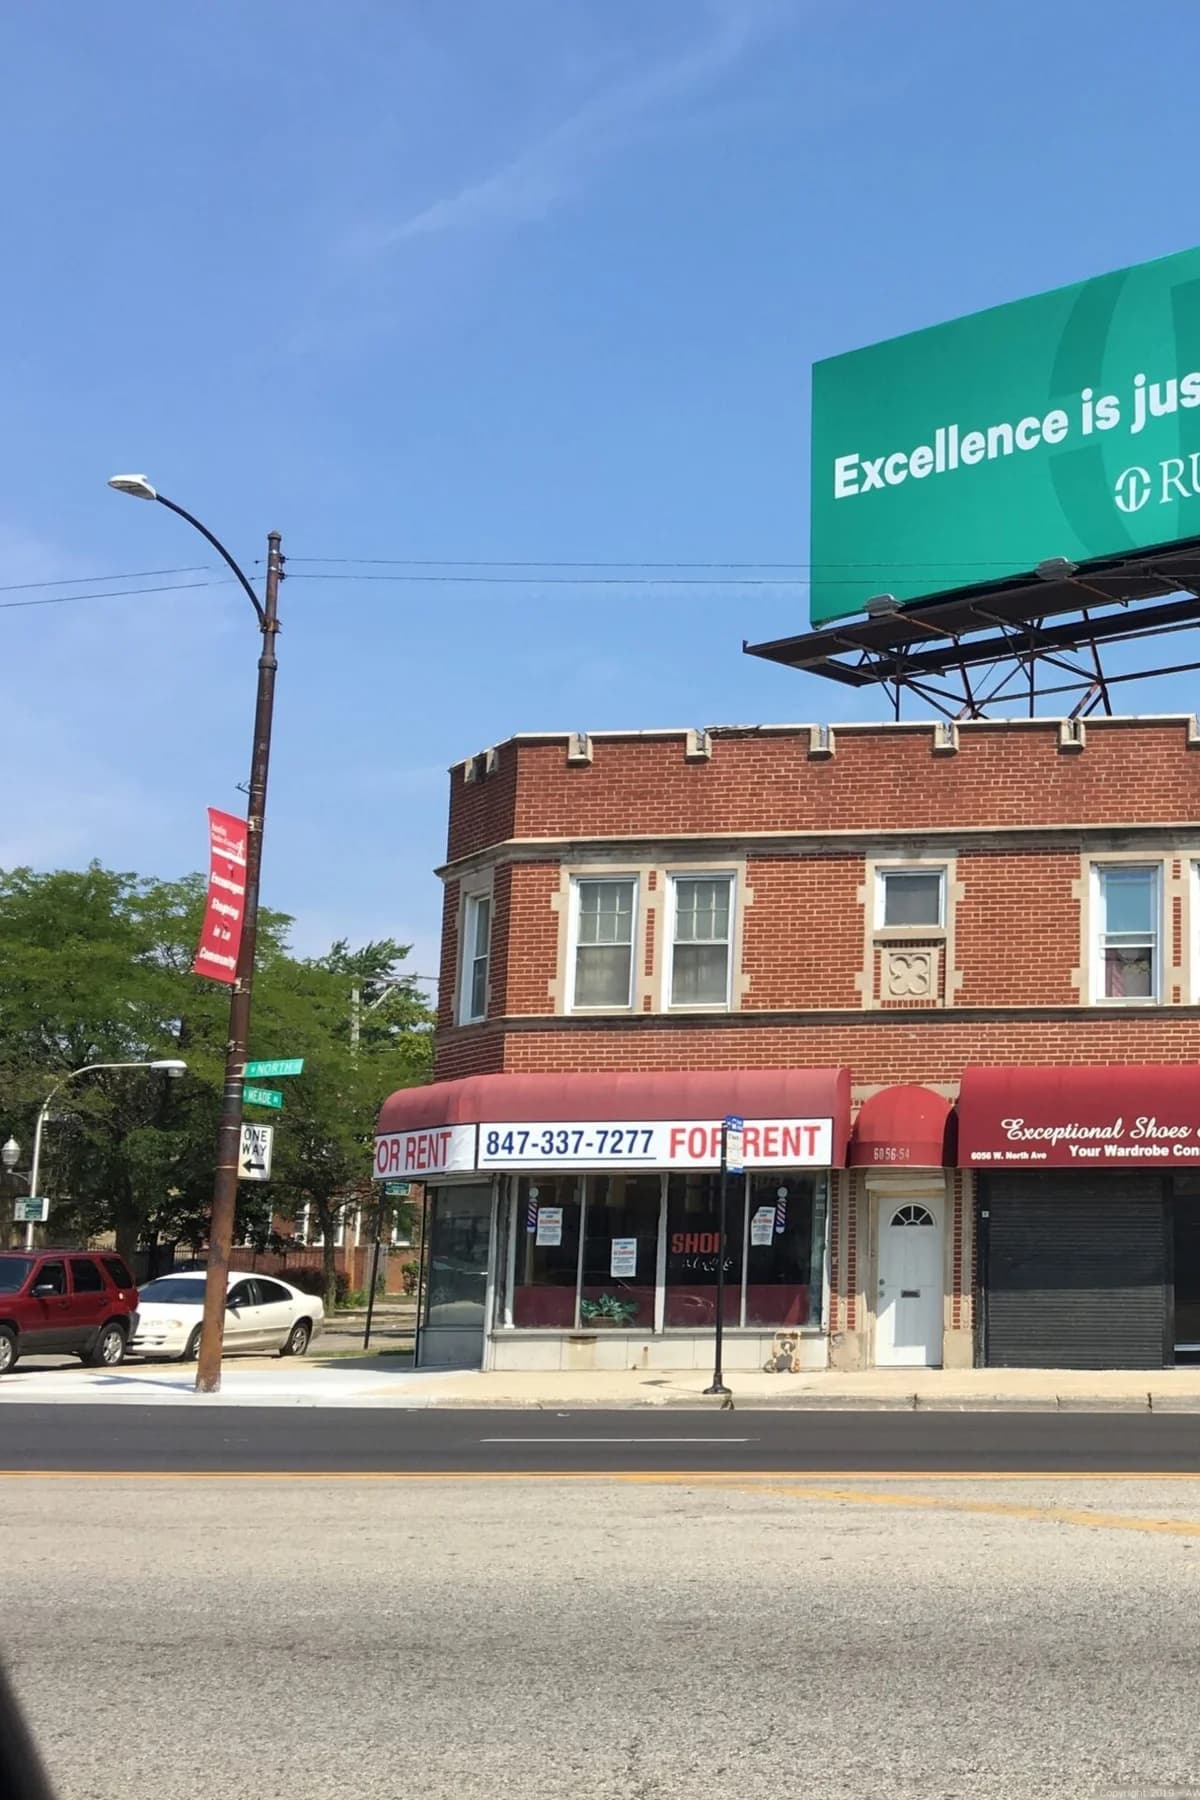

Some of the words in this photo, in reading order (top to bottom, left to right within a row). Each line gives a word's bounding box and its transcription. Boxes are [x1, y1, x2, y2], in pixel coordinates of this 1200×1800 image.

[834, 410, 1069, 499] Excellence
[1081, 389, 1121, 435] is
[257, 1061, 293, 1075] NORTH
[248, 1090, 272, 1106] MEADE
[244, 1128, 268, 1143] ONE
[1000, 1117, 1125, 1147] Exceptional
[1129, 1116, 1192, 1139] Shoes
[486, 1129, 654, 1155] 847-337-7277
[743, 1125, 821, 1158] RENT
[242, 1143, 267, 1158] WAY
[404, 1131, 452, 1170] RENT
[993, 1151, 1004, 1160] W.
[1005, 1151, 1029, 1160] North
[1030, 1151, 1047, 1160] Ave
[1068, 1144, 1102, 1157] Your
[1103, 1144, 1169, 1157] Wardrobe
